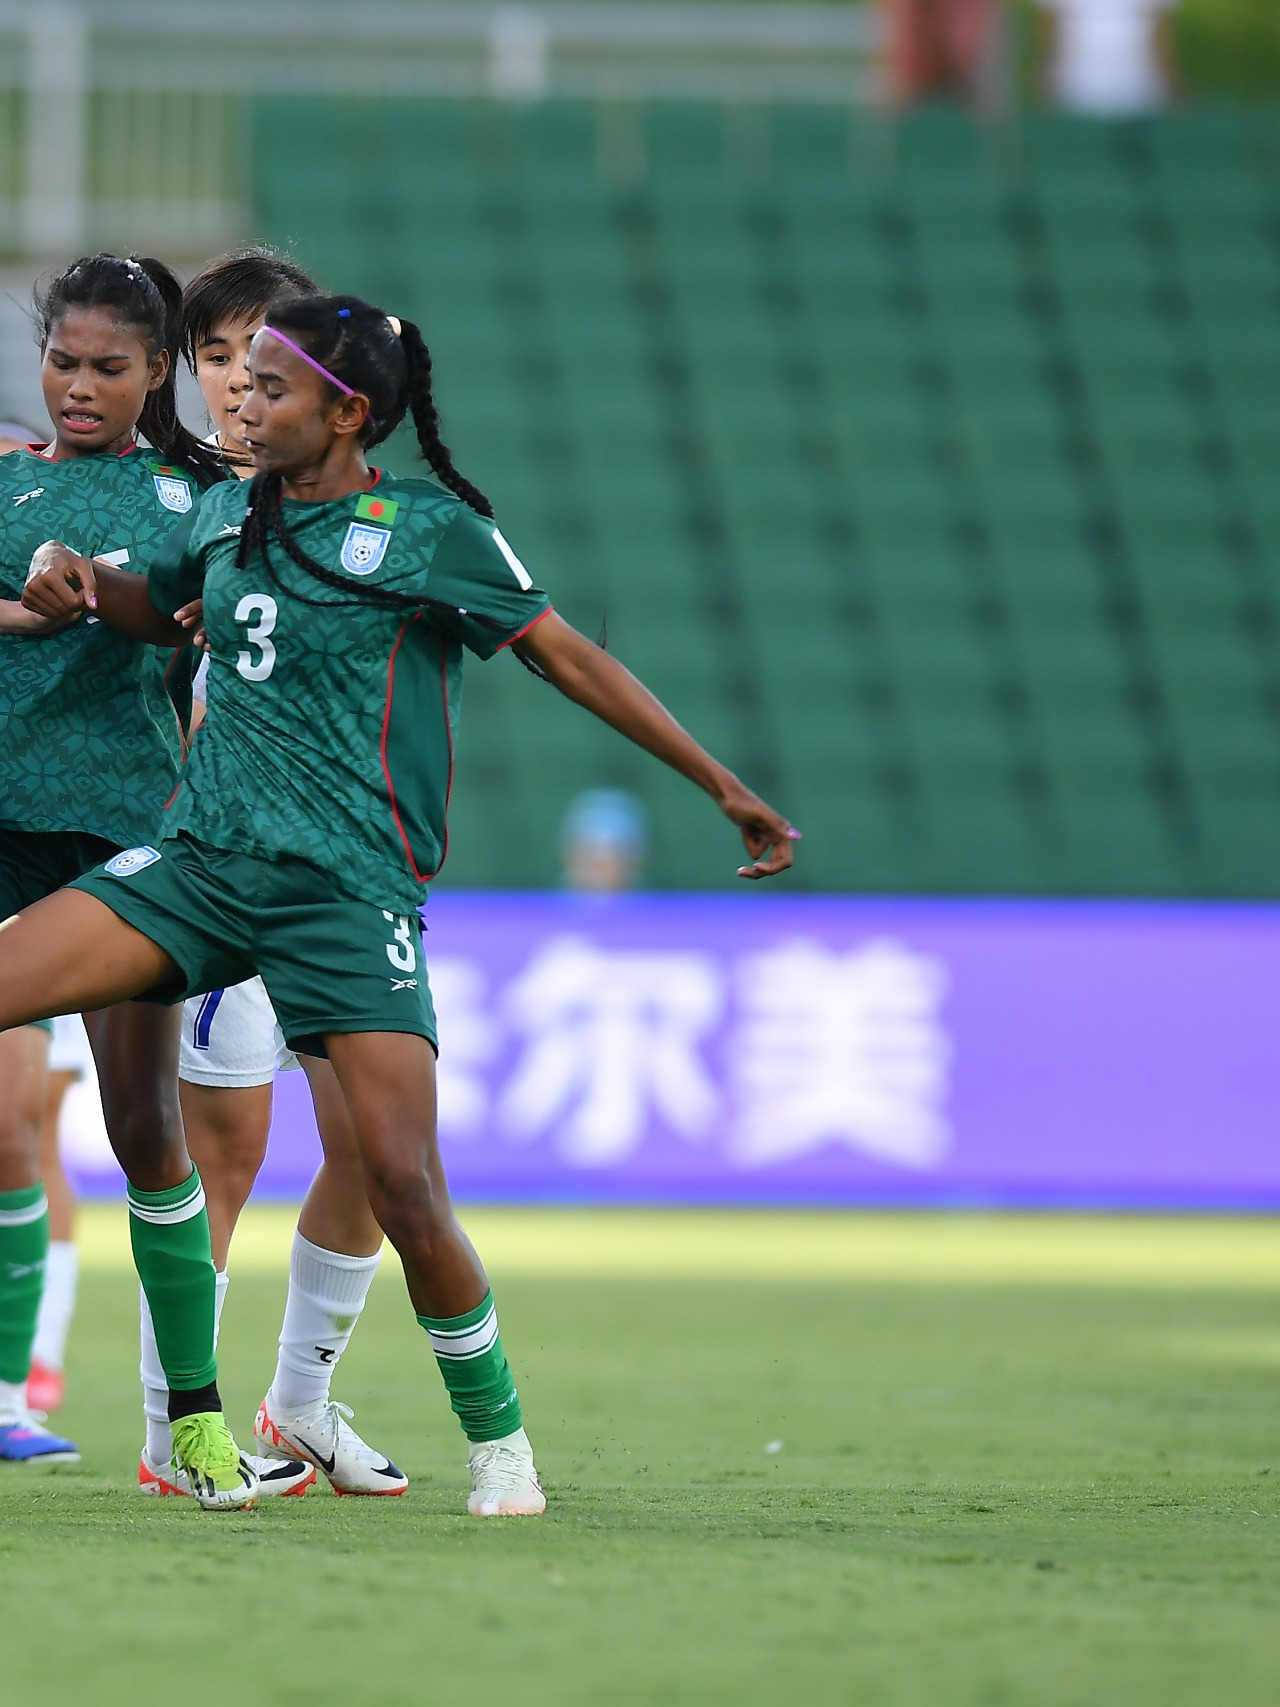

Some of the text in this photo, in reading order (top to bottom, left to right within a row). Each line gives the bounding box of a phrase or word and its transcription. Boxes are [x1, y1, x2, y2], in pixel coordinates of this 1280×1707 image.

[235, 593, 277, 681] 3
[382, 909, 416, 973] 3
[432, 937, 950, 1165] 尔美
